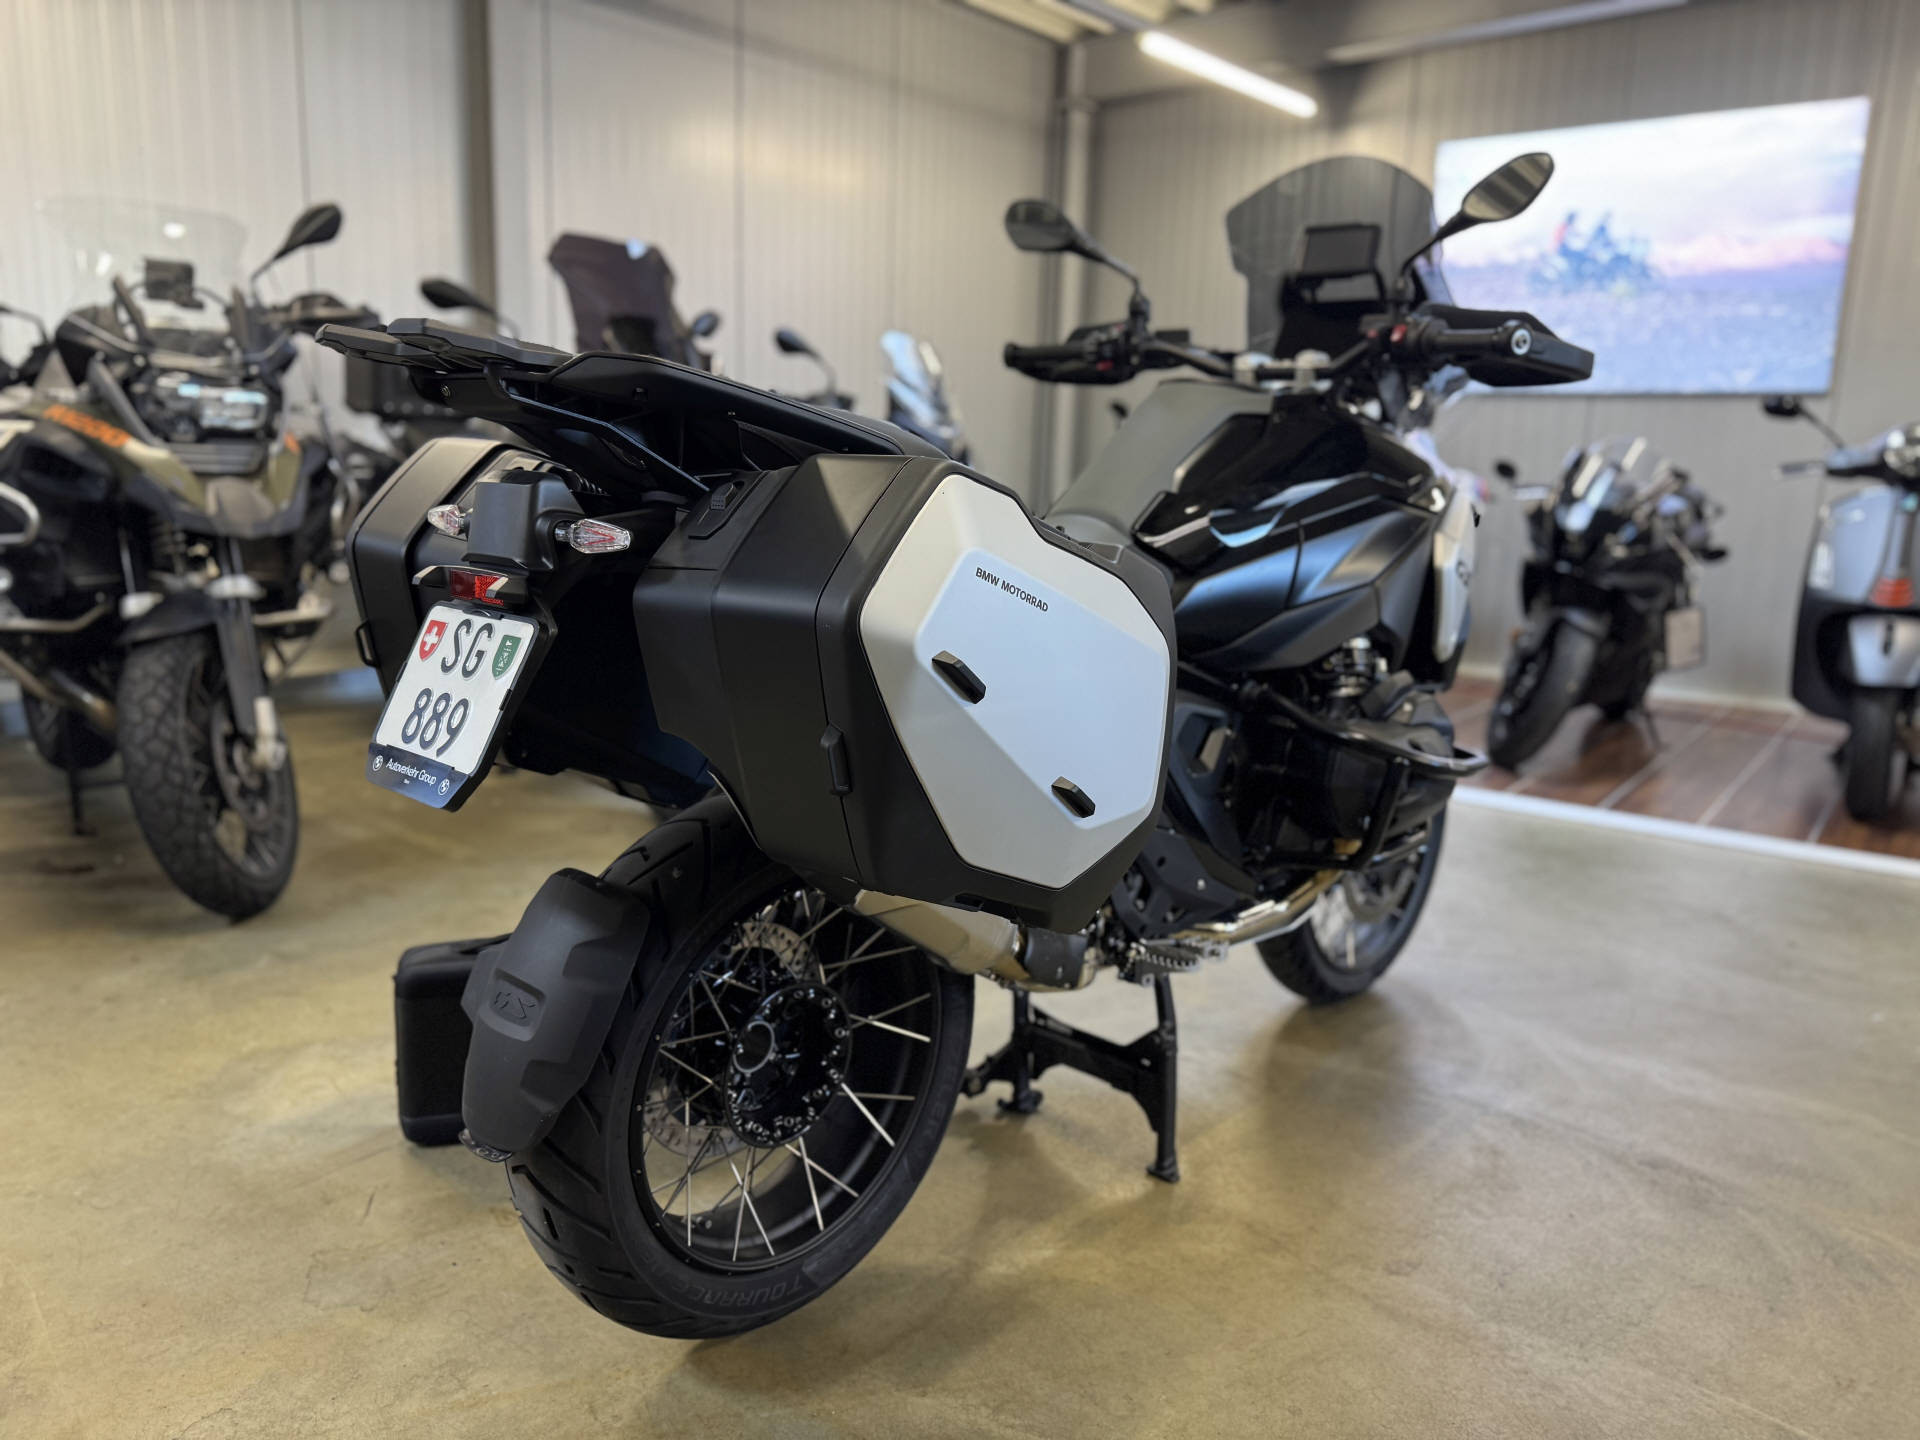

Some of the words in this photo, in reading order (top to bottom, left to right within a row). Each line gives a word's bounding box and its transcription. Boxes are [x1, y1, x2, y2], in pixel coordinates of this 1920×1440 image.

[975, 566, 1000, 586] BMW
[1001, 579, 1049, 612] MOTORRAD
[440, 618, 495, 679] SG
[401, 687, 470, 758] 889
[385, 758, 419, 778] Autoverkehr
[418, 769, 437, 786] Group
